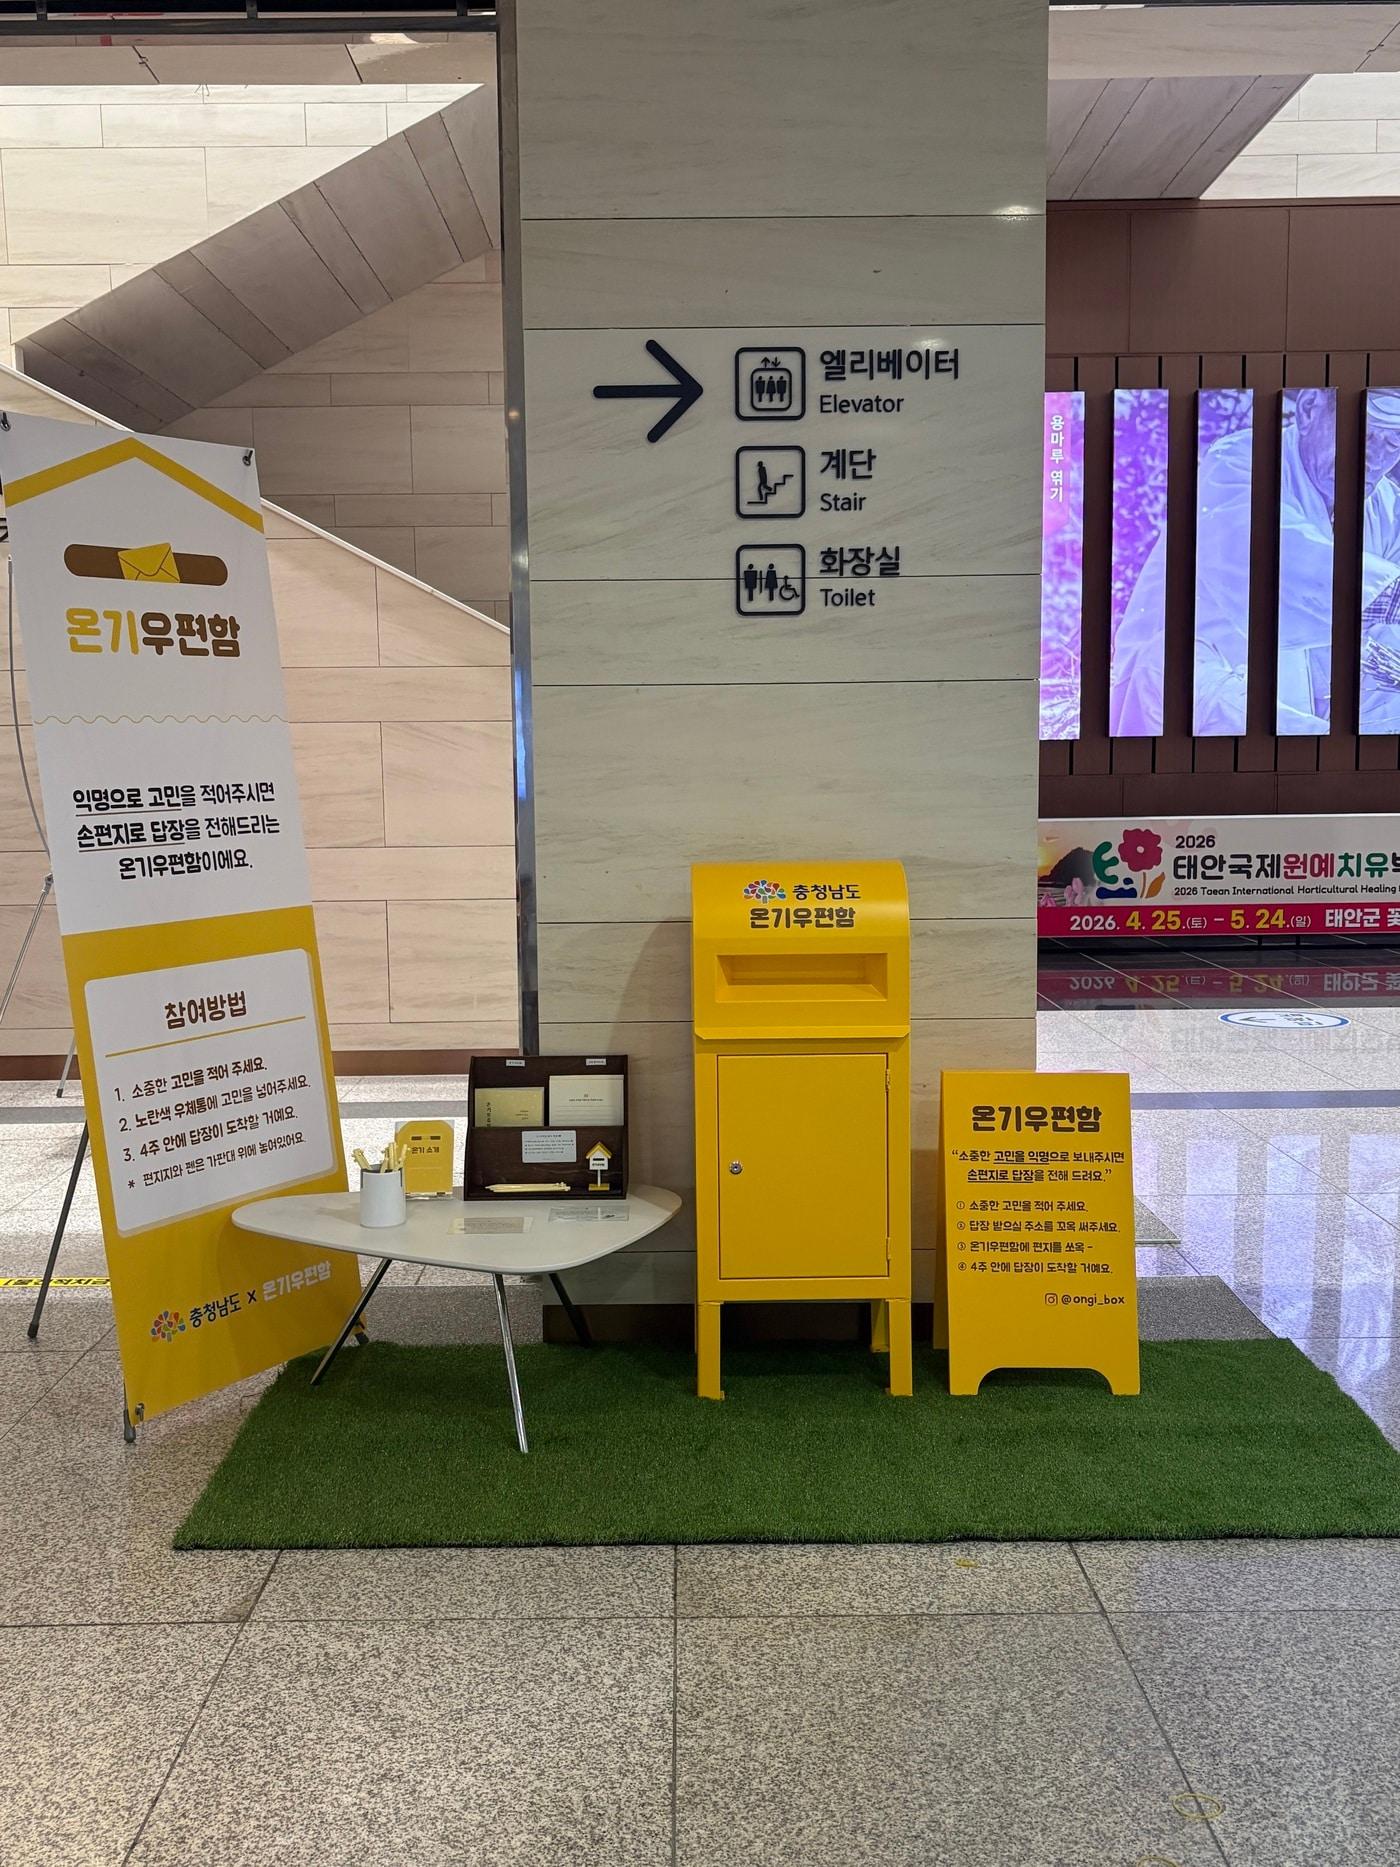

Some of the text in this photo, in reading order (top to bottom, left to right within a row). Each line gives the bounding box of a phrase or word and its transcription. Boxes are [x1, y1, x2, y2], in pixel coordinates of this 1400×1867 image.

[819, 348, 959, 381] 엘리베이터
[819, 394, 904, 414] Elevator
[1050, 415, 1065, 464] 용마루
[819, 448, 876, 481] 계단
[819, 492, 866, 512] Stair
[819, 546, 901, 577] 화장실
[819, 588, 875, 607] Toilet
[66, 607, 241, 658] 온기우편함
[73, 782, 275, 812] 익명으로 고민을 적어주시면
[77, 814, 280, 848] 손편지로 답장을 전해드리는
[1175, 835, 1216, 849] 2026
[119, 849, 253, 880] 온기우편함이에요.
[793, 884, 861, 900] 충청남도
[1174, 887, 1198, 896] 2026
[1200, 886, 1230, 896] Taean
[1232, 886, 1294, 896] International
[1298, 885, 1358, 894] Horticultural
[1360, 884, 1396, 894] Healing
[750, 907, 856, 929] 온기우편함
[1070, 915, 1120, 931] 2026.
[1126, 911, 1145, 930] 4.
[1325, 908, 1380, 928] 태안군
[164, 990, 247, 1030] 참여방법
[114, 1056, 268, 1102] 1. 소중한 고민을 적어 주세요.
[119, 1074, 311, 1132] 2. 노란색 우체통에 고민을 넣어주세요.
[971, 1104, 1102, 1133] 온기우편함
[123, 1106, 298, 1162] 3. 4주 안에 답장이 도착할 거예요.
[143, 1164, 183, 1187] 편지지와
[185, 1158, 205, 1175] 펜은
[207, 1149, 236, 1168] 가판대
[237, 1142, 257, 1160] 위에
[952, 1150, 1125, 1164] “소중한 고민을 익명으로 보내주시면
[967, 1169, 1008, 1181] 손편지로
[1012, 1169, 1044, 1182] 답장을
[1047, 1169, 1068, 1182] 전해
[969, 1200, 999, 1212] 소중한
[1002, 1201, 1031, 1212] 고민을
[1034, 1201, 1053, 1212] 적어
[1056, 1201, 1088, 1212] 주세요.
[969, 1220, 990, 1232] 답장
[992, 1221, 1022, 1232] 받으실
[1024, 1221, 1053, 1232] 주소를
[1056, 1221, 1076, 1232] 꼬옥
[1078, 1222, 1121, 1233] 써주세요.
[970, 1241, 1030, 1253] 온기우편함에
[1032, 1241, 1062, 1253] 편지를
[970, 1262, 987, 1272] 4주
[990, 1262, 1010, 1273] 안에
[1013, 1262, 1044, 1273] 답장이
[1047, 1262, 1077, 1273] 도착할
[1080, 1263, 1113, 1274] 거예요.
[189, 1292, 241, 1328] 충청남도
[262, 1260, 332, 1302] 온기우편함
[1061, 1293, 1125, 1307] @ongi_box
